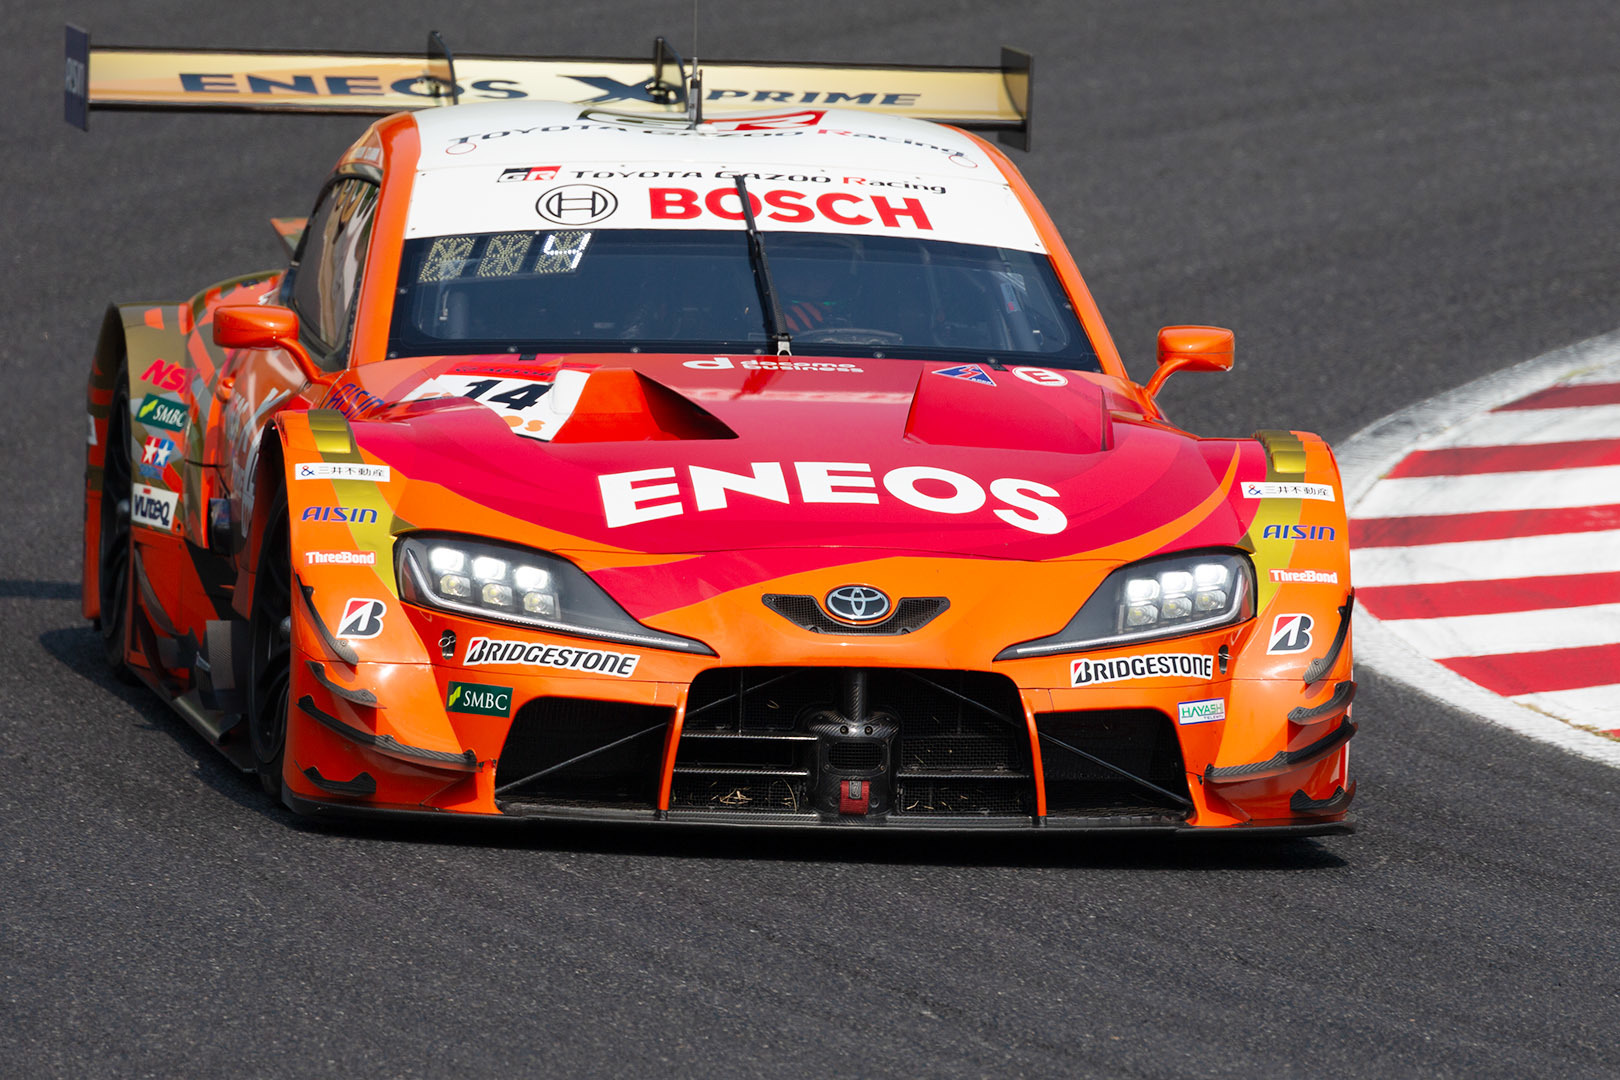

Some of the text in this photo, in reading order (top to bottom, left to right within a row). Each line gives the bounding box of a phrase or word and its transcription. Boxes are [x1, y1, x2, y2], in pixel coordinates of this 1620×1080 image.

[179, 73, 528, 99] ENEOS
[706, 88, 921, 106] PRIME
[570, 170, 702, 179] TOYOTA
[842, 176, 946, 194] Racing
[648, 187, 933, 230] BOSCH
[463, 379, 555, 411] 14
[152, 404, 188, 428] SMBC
[598, 461, 1068, 534] ENEOS
[301, 506, 377, 523] AISIN
[1262, 524, 1335, 541] AISIN
[306, 551, 375, 565] ThreeBond
[1270, 569, 1338, 584] ThreeBond
[467, 639, 638, 676] BRIDGESTONE
[1074, 655, 1213, 684] BRIDGESTONE
[463, 690, 508, 712] SMBC
